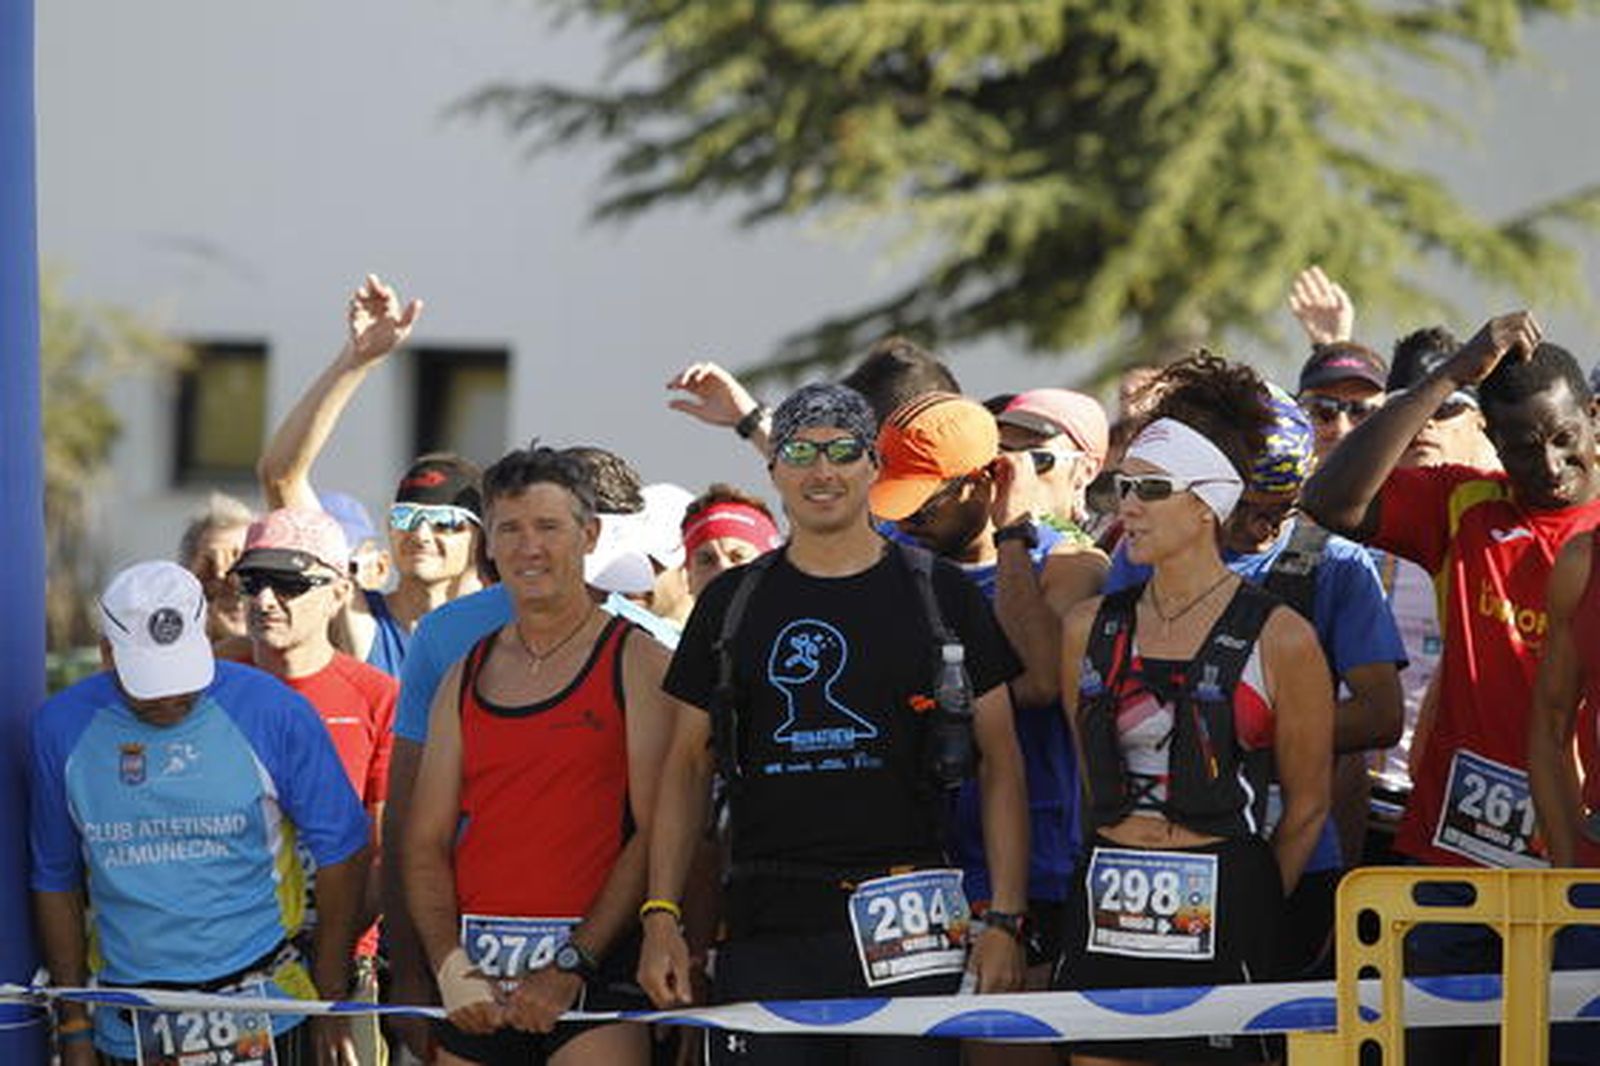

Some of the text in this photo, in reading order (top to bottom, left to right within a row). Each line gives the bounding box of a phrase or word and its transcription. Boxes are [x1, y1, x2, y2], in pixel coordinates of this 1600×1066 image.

[138, 813, 247, 838] ATLETISMO
[1457, 773, 1536, 836] 261
[84, 821, 134, 842] CLUB
[1100, 868, 1181, 915] 298
[868, 888, 951, 942] 284
[477, 933, 555, 977] 274
[152, 1010, 237, 1055] 128
